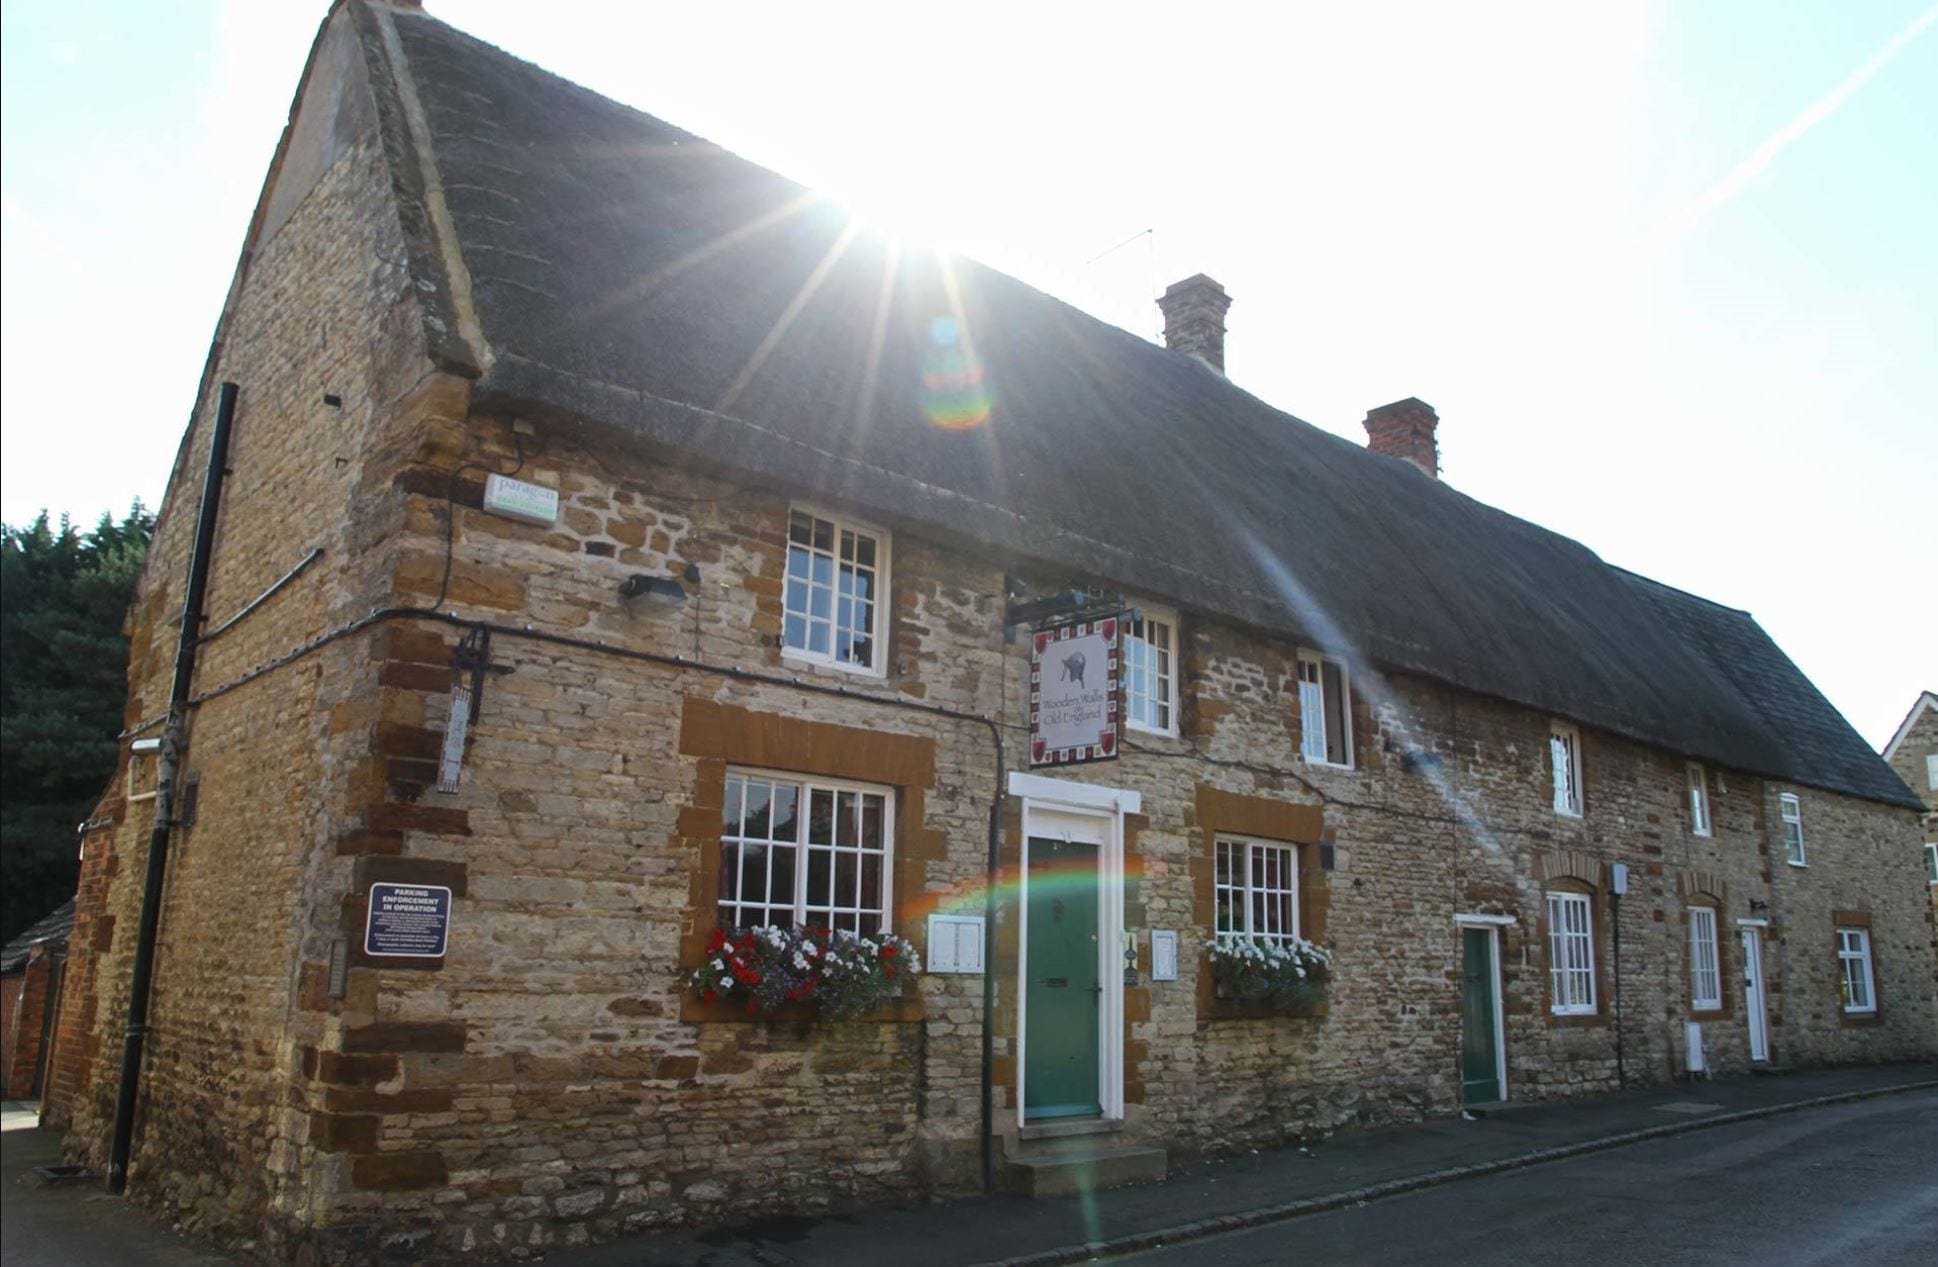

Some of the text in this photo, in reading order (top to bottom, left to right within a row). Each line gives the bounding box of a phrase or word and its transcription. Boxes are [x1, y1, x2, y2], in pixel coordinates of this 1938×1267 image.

[1043, 693, 1079, 709] Wooden
[1044, 703, 1101, 727] Old England
[394, 889, 429, 897] PARKING
[382, 896, 439, 905] ENFORCEMENT
[383, 903, 437, 912] IN OPERATION
